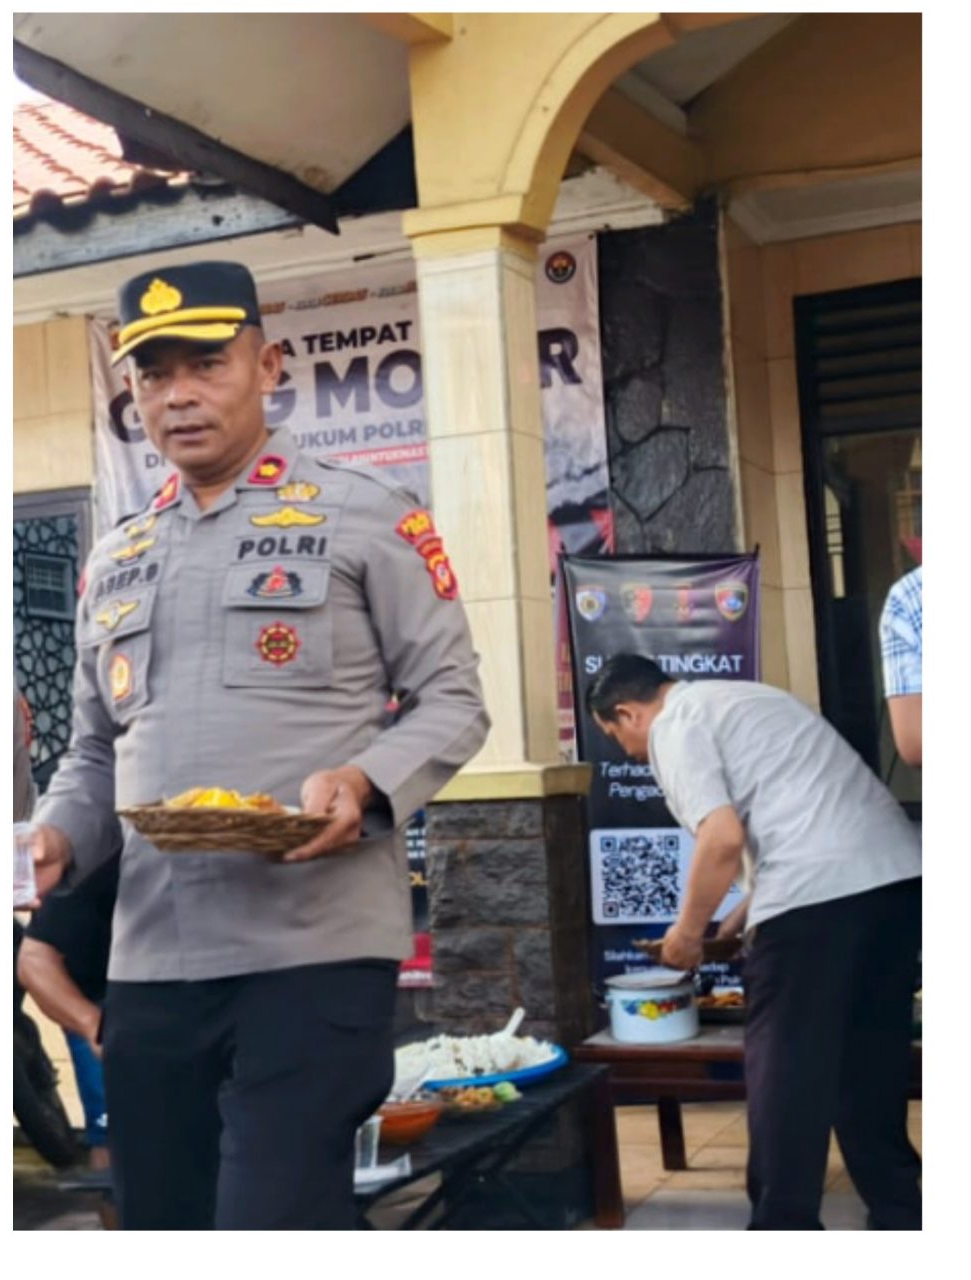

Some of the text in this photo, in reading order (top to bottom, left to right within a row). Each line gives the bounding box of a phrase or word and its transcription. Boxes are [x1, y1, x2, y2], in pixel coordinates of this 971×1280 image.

[302, 321, 413, 355] TEMPAT
[295, 428, 357, 451] UKUM
[237, 535, 327, 559] POLRI
[658, 654, 743, 673] TINGKAT
